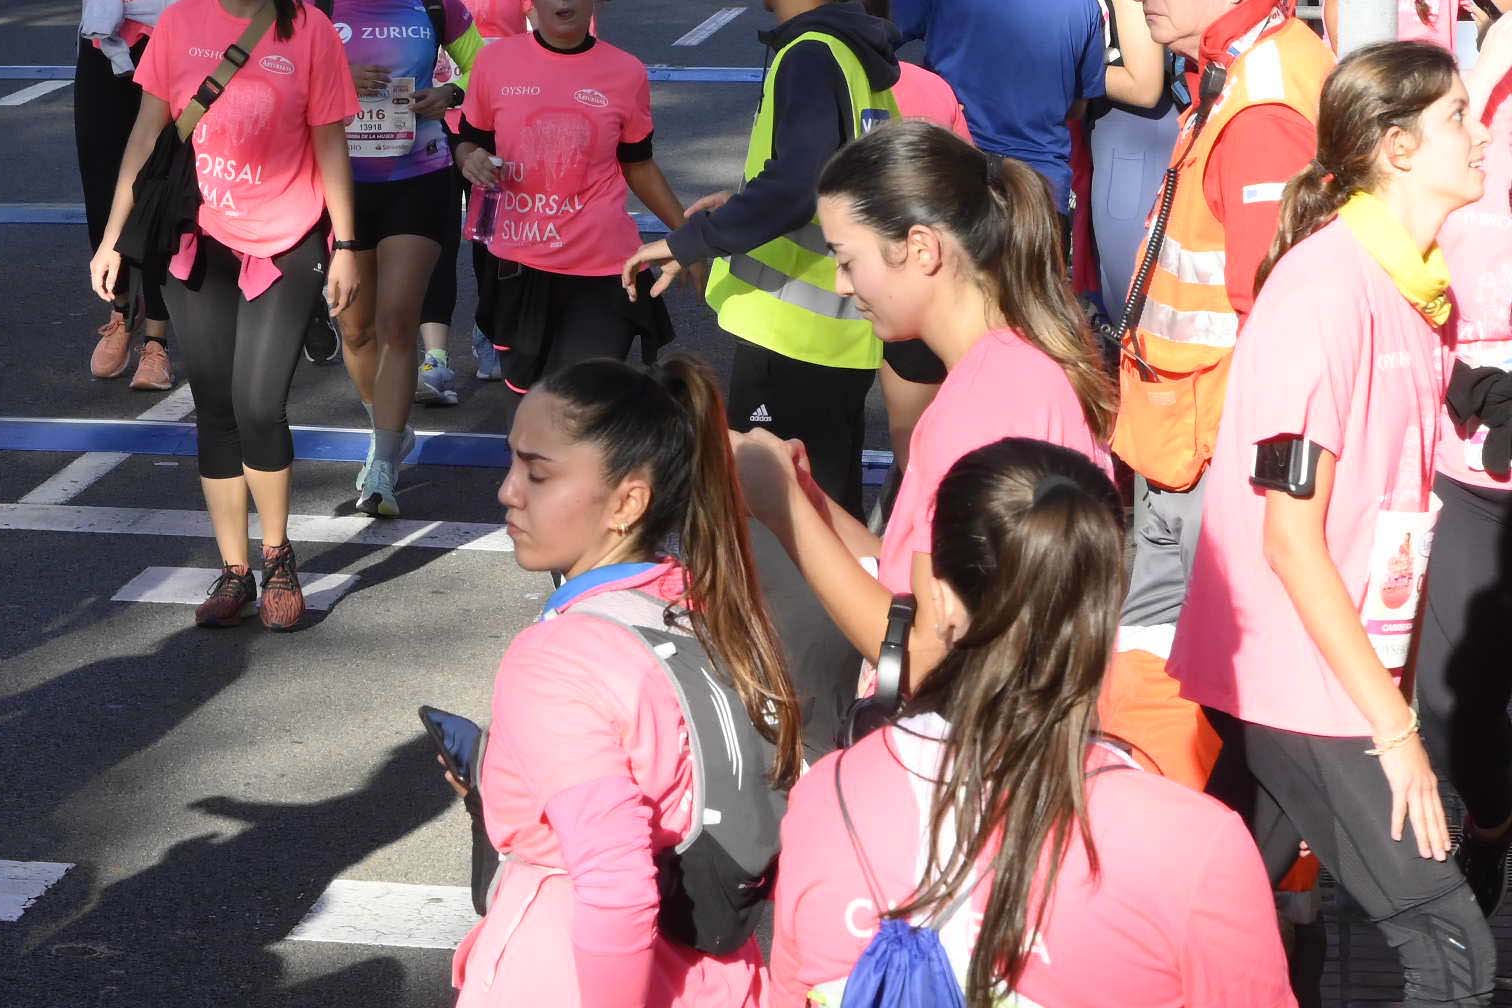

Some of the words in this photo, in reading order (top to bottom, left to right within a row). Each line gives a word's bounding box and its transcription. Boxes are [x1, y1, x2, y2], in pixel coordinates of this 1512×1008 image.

[361, 26, 431, 40] ZURICH
[501, 85, 541, 96] OYSHO
[503, 191, 584, 216] DORSAL
[502, 220, 561, 242] SUMA
[749, 415, 773, 423] adidas
